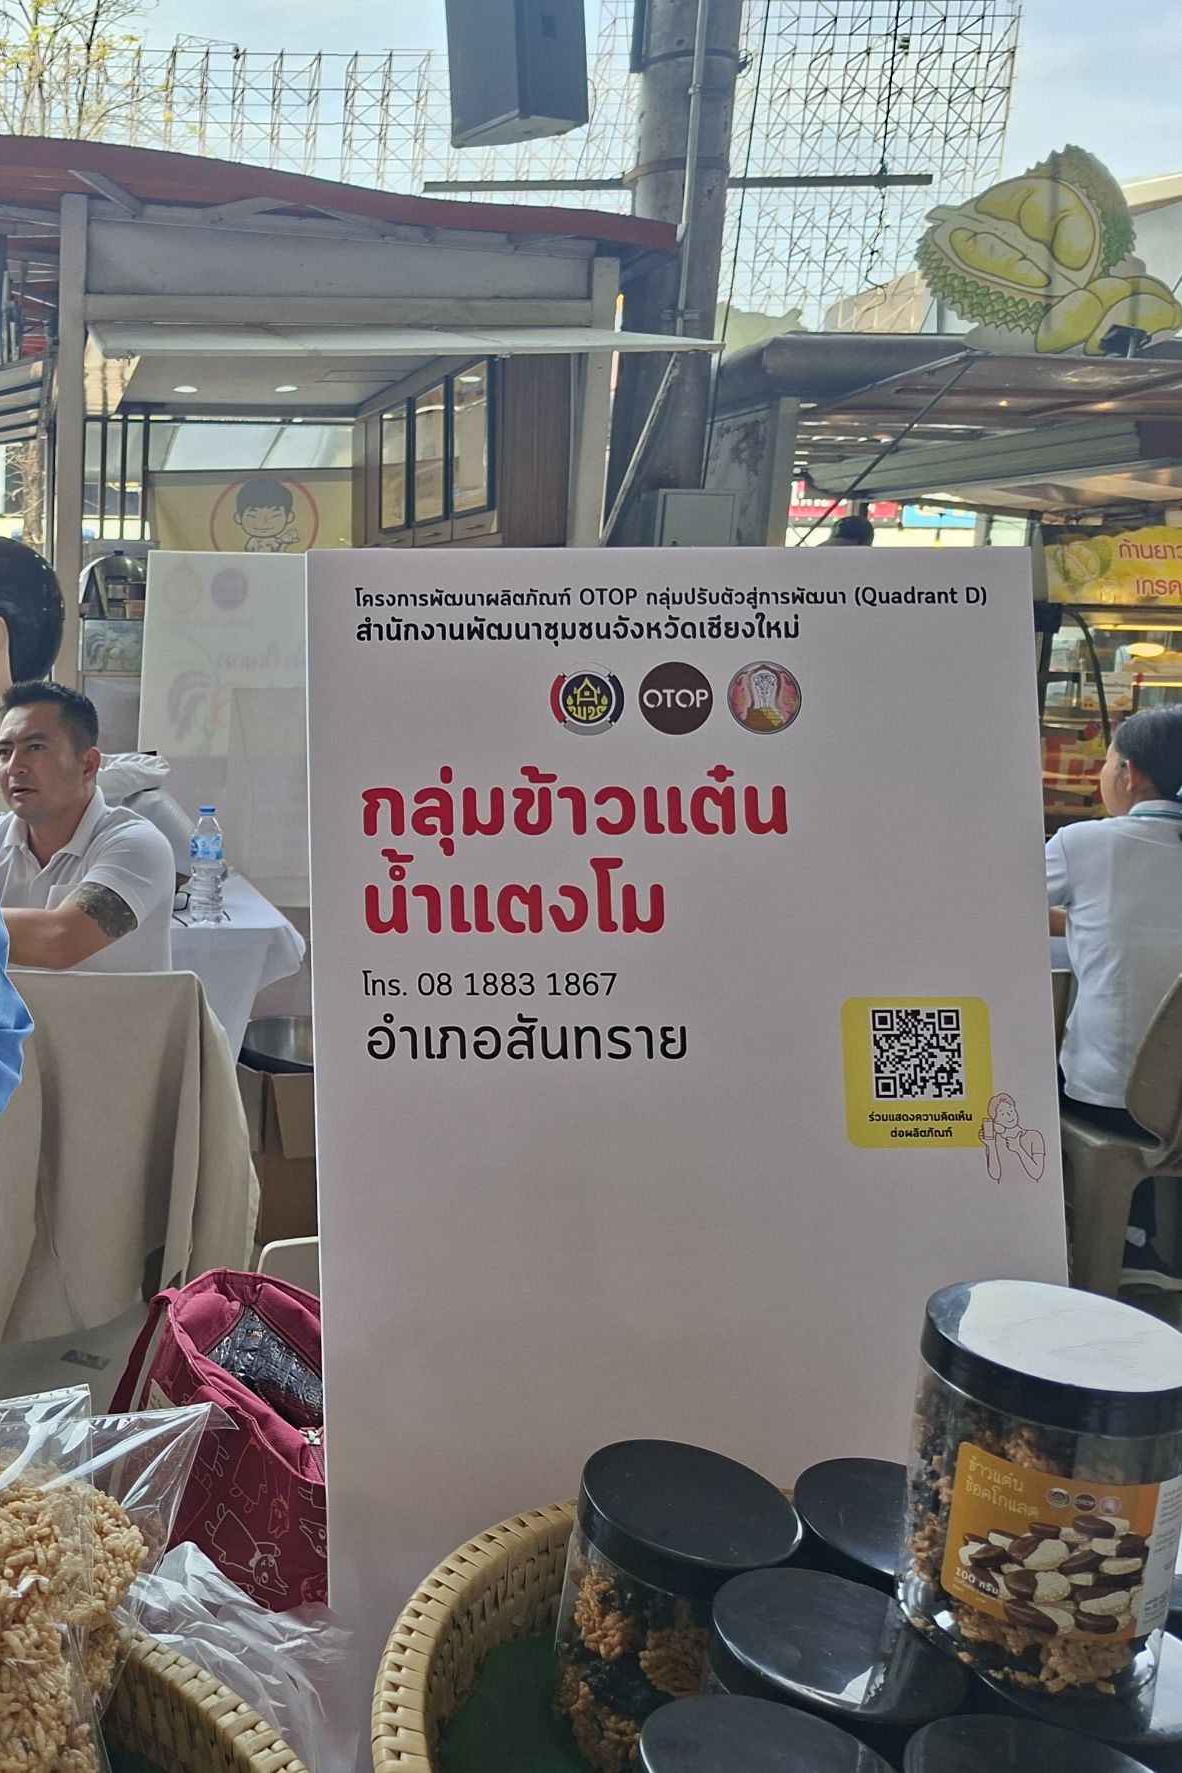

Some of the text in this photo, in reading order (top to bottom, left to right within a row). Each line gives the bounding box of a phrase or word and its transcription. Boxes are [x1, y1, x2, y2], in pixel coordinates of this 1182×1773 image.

[355, 586, 987, 610] โครงการพัฒนาผลิตภัณฑ์ OTOP กลุ่มปรับตัวสู่การพัฒนา (Quadrant D)
[356, 612, 800, 647] สำนักงานพัฒนาชุมชนจังหวัดเชียงใหม่
[642, 688, 709, 709] OTOP
[362, 764, 788, 856] กลุ่มข้าวแต๋น
[365, 848, 665, 934] น้ำแตงโม
[362, 970, 617, 997] โทร. 08 1883 1867
[367, 1012, 687, 1060] อำเภอสันทราย
[868, 1109, 973, 1122] ร่วมแสดงความคิดเห็น
[890, 1126, 953, 1138] ต่อผลิตภัณฑ์
[955, 1566, 976, 1583] 100
